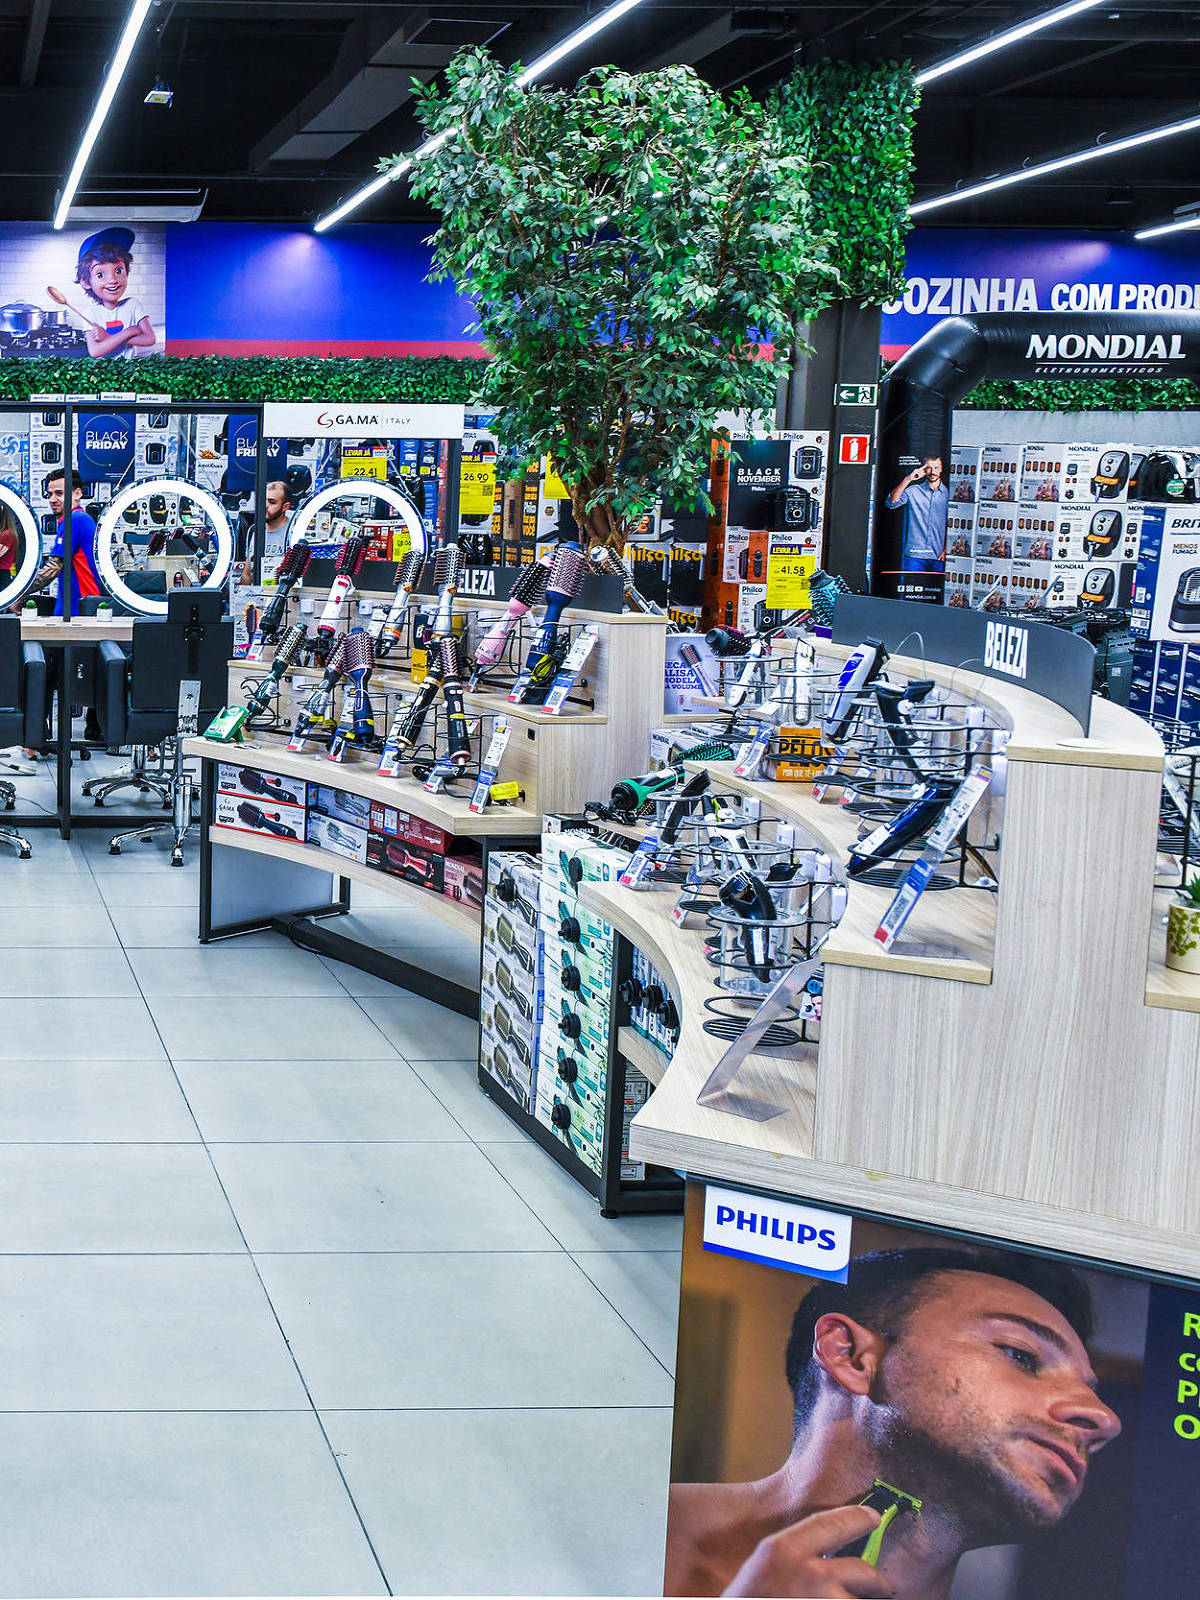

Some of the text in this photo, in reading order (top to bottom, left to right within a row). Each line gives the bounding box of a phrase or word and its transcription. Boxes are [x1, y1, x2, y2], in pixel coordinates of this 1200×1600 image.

[1051, 283, 1113, 311] COM
[1025, 334, 1187, 359] MONDIAL
[1035, 366, 1164, 374] ELETRODOMÉSTICOS
[86, 431, 128, 441] BLACK
[783, 432, 804, 440] Philco
[86, 441, 128, 450] FRIDAY
[345, 448, 362, 457] LEVAR
[464, 472, 489, 483] 26.90
[626, 545, 666, 562] hilco
[457, 569, 496, 596] ELEZA
[984, 620, 1029, 679] BELEZA
[716, 1204, 836, 1251] PHILIPS
